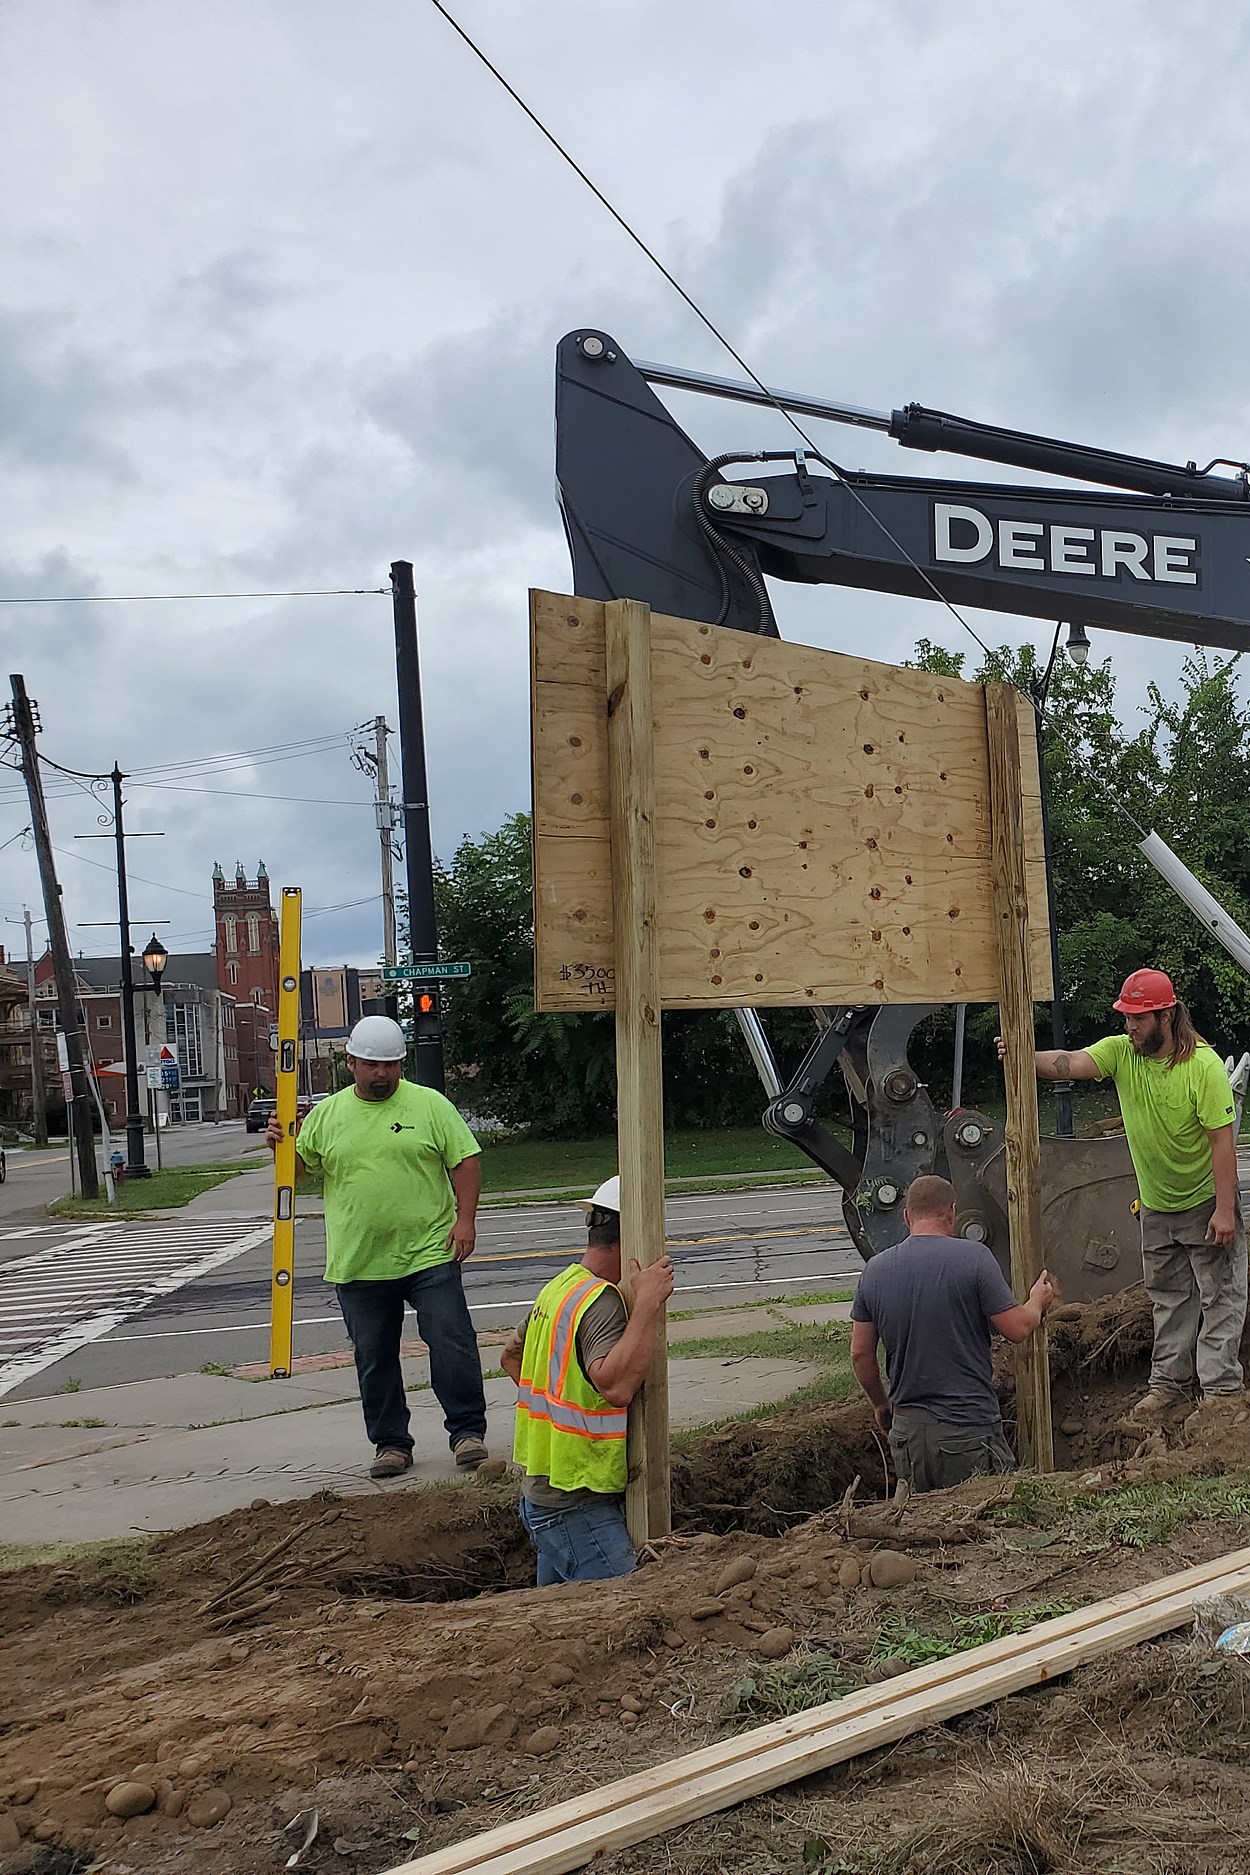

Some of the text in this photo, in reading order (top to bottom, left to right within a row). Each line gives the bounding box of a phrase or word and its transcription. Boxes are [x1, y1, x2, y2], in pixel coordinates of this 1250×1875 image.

[935, 503, 1197, 584] DEERE
[403, 965, 464, 976] CHAPMAN ST
